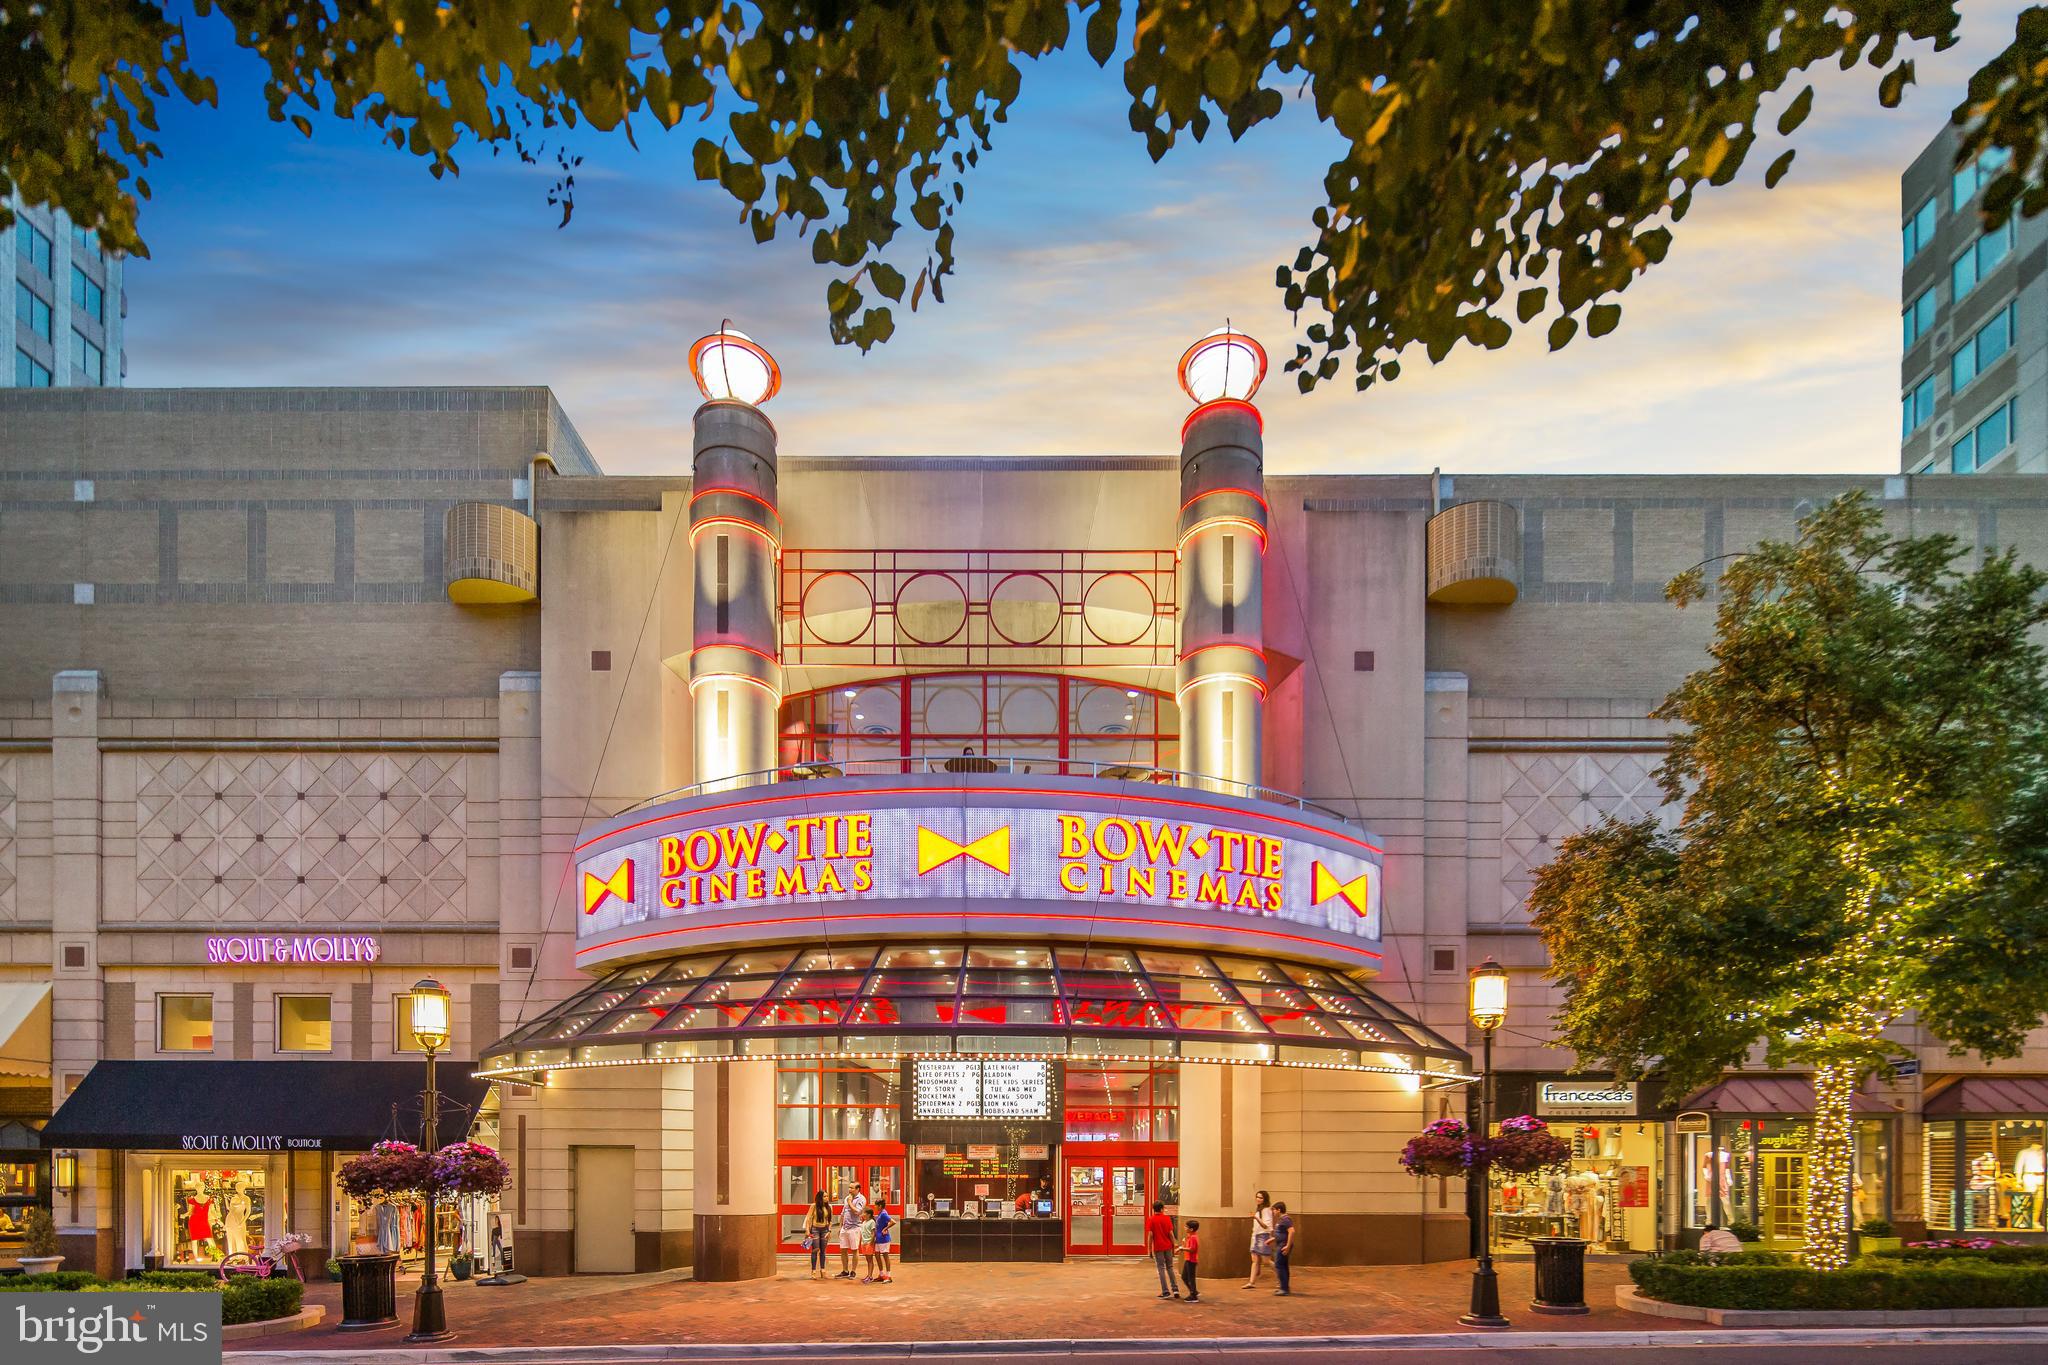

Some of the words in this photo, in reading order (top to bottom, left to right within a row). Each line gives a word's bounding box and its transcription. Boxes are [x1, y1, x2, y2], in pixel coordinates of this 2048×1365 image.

[660, 860, 873, 909] CINEMAS
[1059, 862, 1283, 912] CINEMAS
[207, 937, 269, 963] SCOUT
[274, 937, 289, 962] &
[292, 937, 375, 962] MOLLY'S
[182, 1135, 219, 1150] SCOUT
[222, 1135, 228, 1150] &
[232, 1135, 282, 1150] MOLLY'S
[288, 1139, 322, 1147] BOUTIQUE
